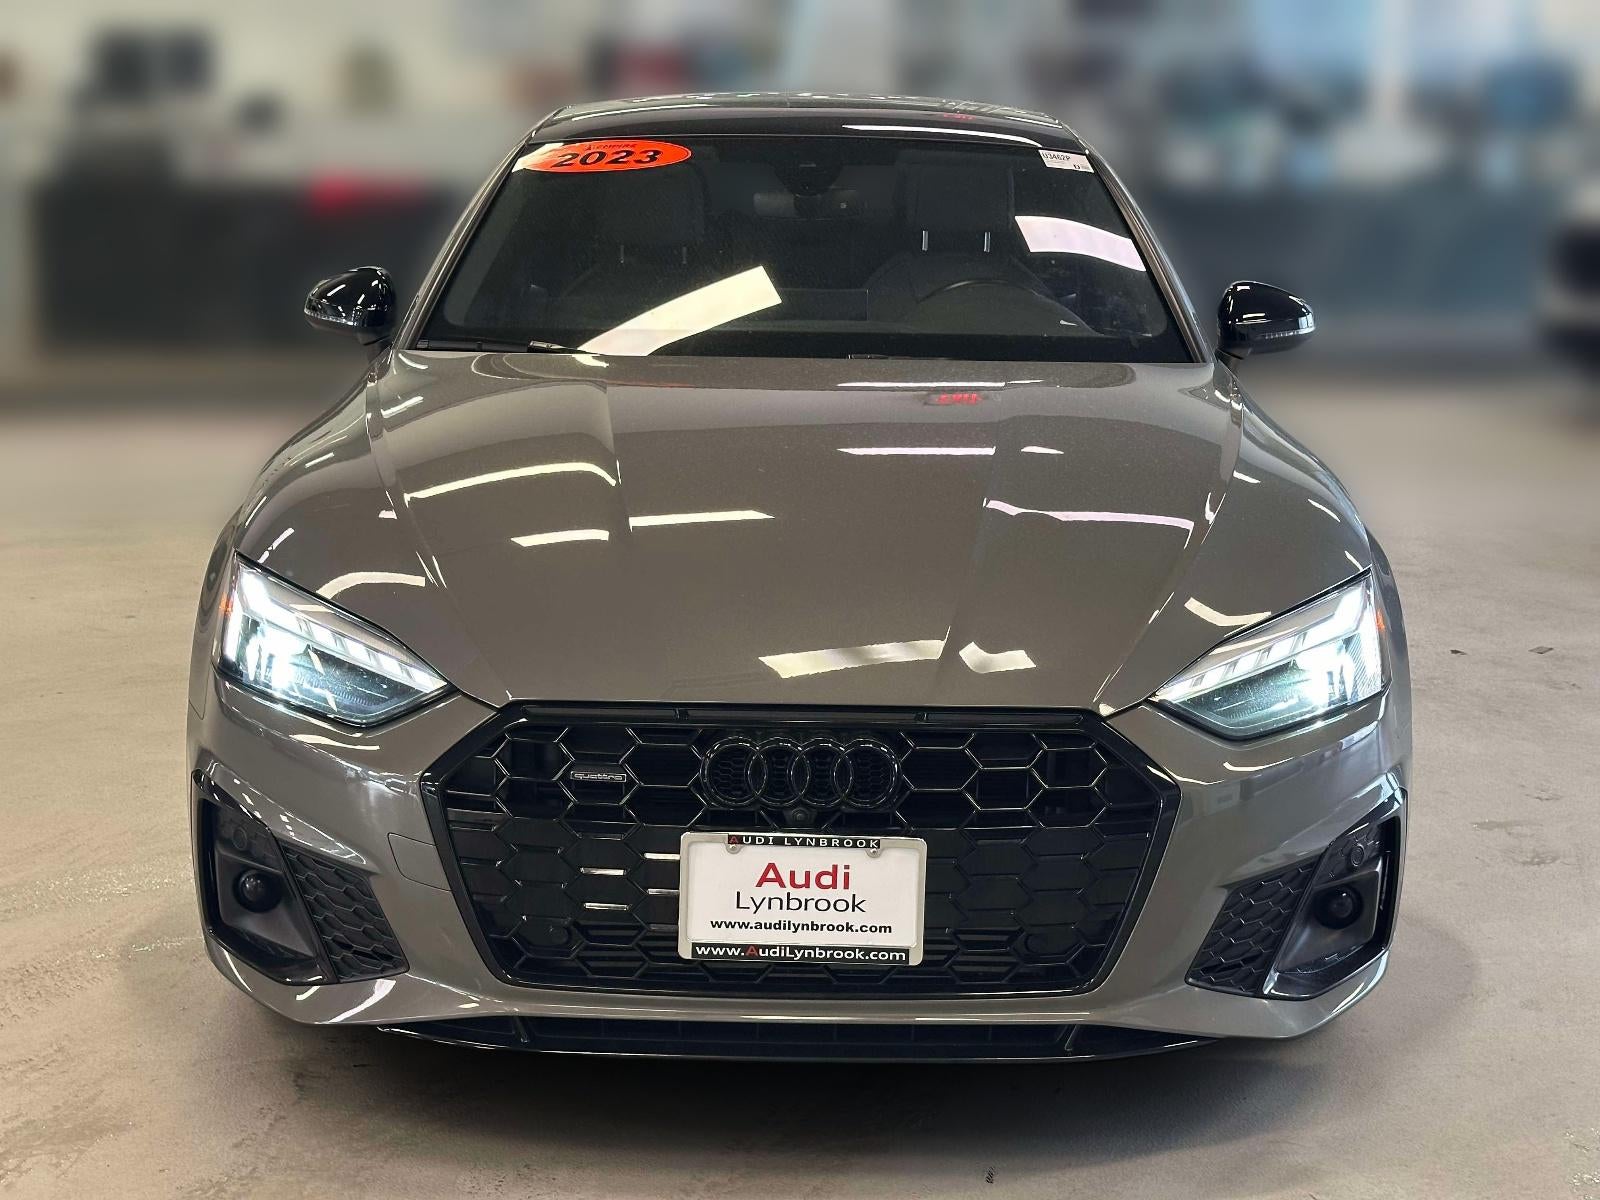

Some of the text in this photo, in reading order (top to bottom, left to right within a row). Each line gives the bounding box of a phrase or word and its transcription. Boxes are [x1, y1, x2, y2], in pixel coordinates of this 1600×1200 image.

[552, 150, 662, 168] 2023
[730, 835, 879, 848] AUDI LYNBROOK
[755, 862, 851, 890] Audi
[736, 891, 867, 914] Lynbrook
[710, 919, 893, 934] www.audilynbrook.com
[695, 944, 907, 961] www.AudiLynbrook.com
